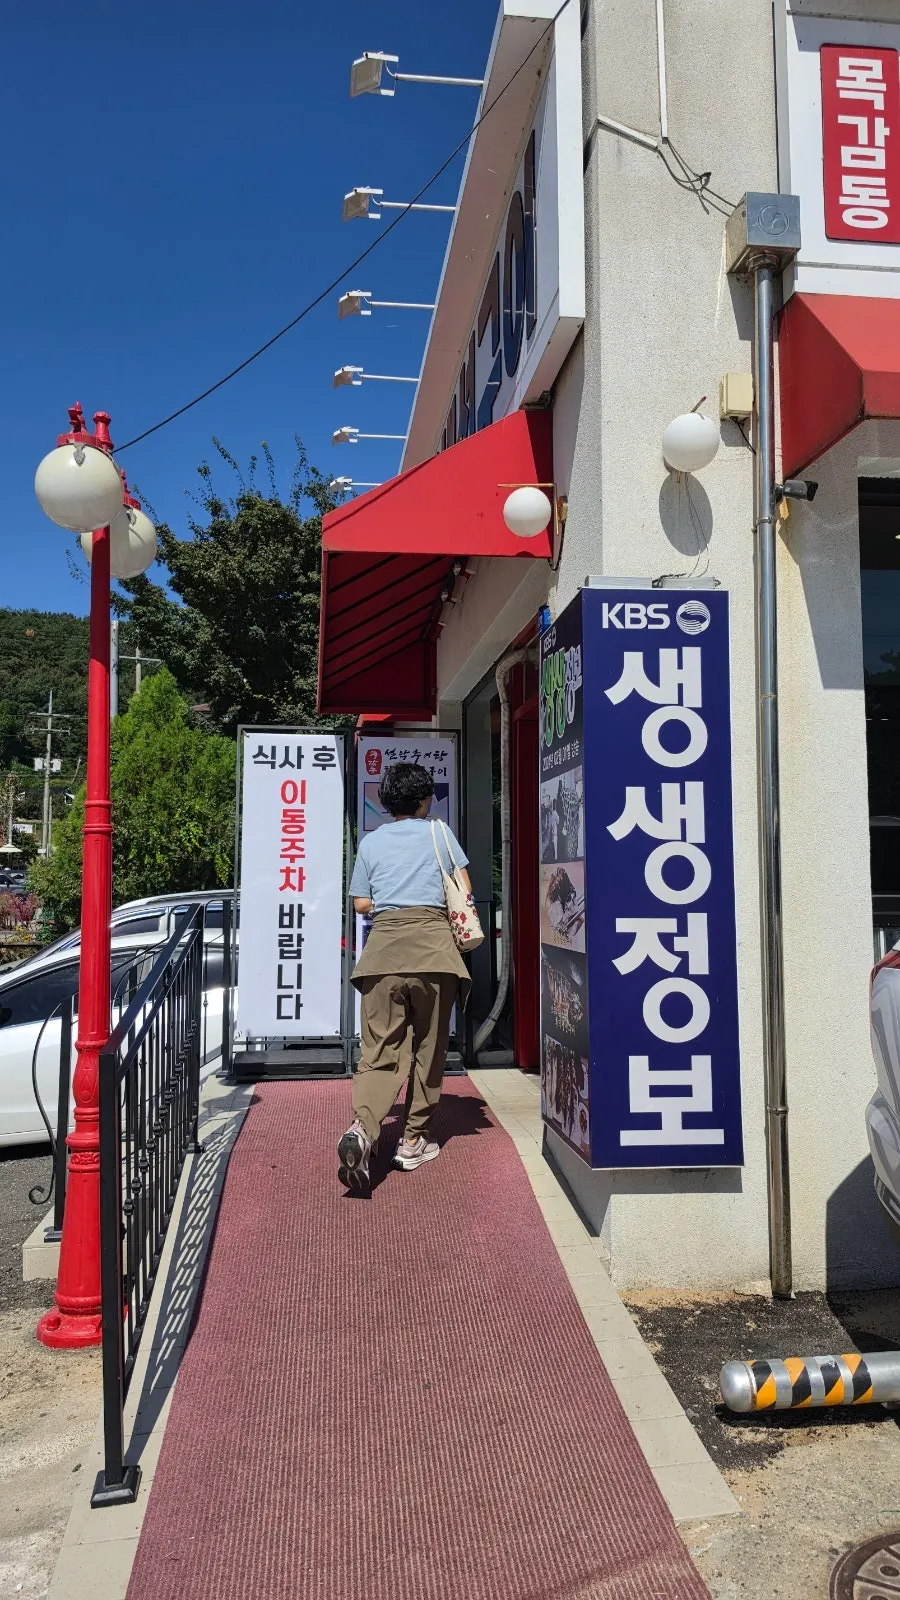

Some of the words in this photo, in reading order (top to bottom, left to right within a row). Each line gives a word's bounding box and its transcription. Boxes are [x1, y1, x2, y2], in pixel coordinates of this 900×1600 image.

[835, 57, 890, 230] 목감동
[602, 603, 670, 629] KBS
[252, 745, 305, 770] 식사
[312, 745, 337, 771] 후
[279, 779, 306, 893] 이동주차
[604, 647, 725, 1146] 생생정보
[276, 903, 306, 1021] 바랍니다
